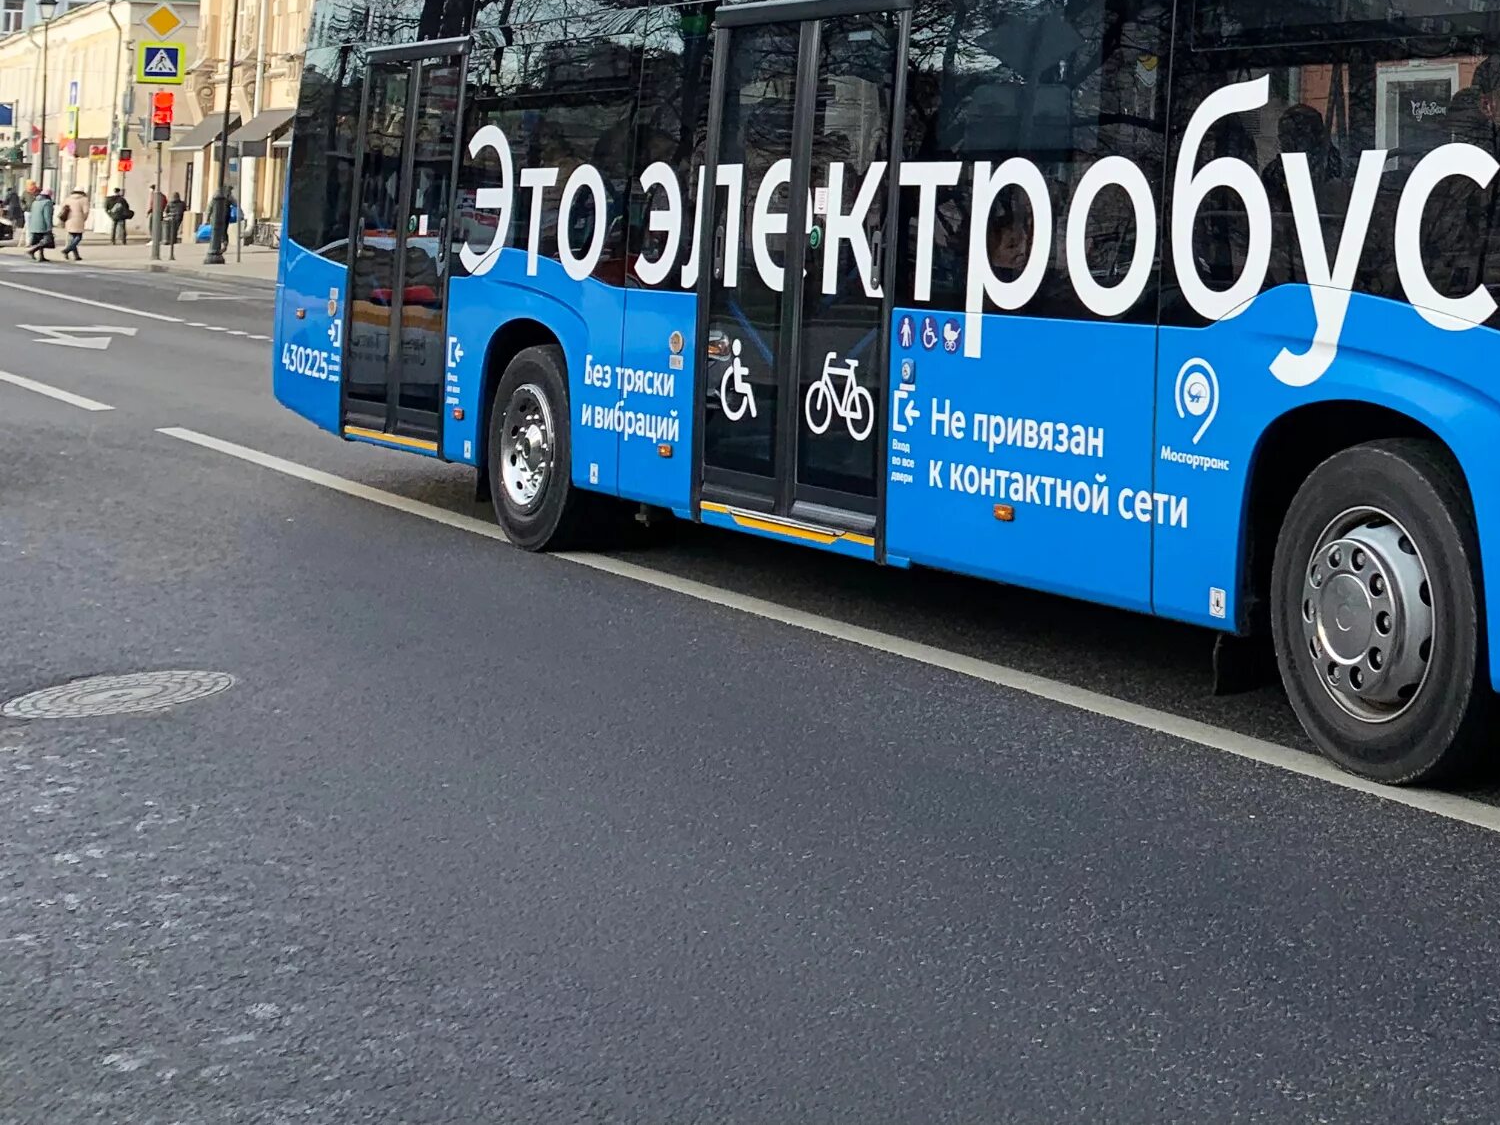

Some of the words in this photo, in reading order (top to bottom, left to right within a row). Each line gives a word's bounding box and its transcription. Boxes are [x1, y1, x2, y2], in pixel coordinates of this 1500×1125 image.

[460, 125, 607, 281] Это
[281, 342, 328, 380] 430225
[584, 354, 612, 389] Без
[615, 366, 675, 398] тряски
[581, 403, 592, 426] и
[594, 400, 679, 443] вибраций
[930, 398, 966, 440] Не
[973, 412, 1104, 457] привязан
[1160, 445, 1230, 472] Мосгортранс
[928, 460, 943, 488] к
[949, 463, 1109, 516] контактной
[1117, 487, 1188, 529] сети
